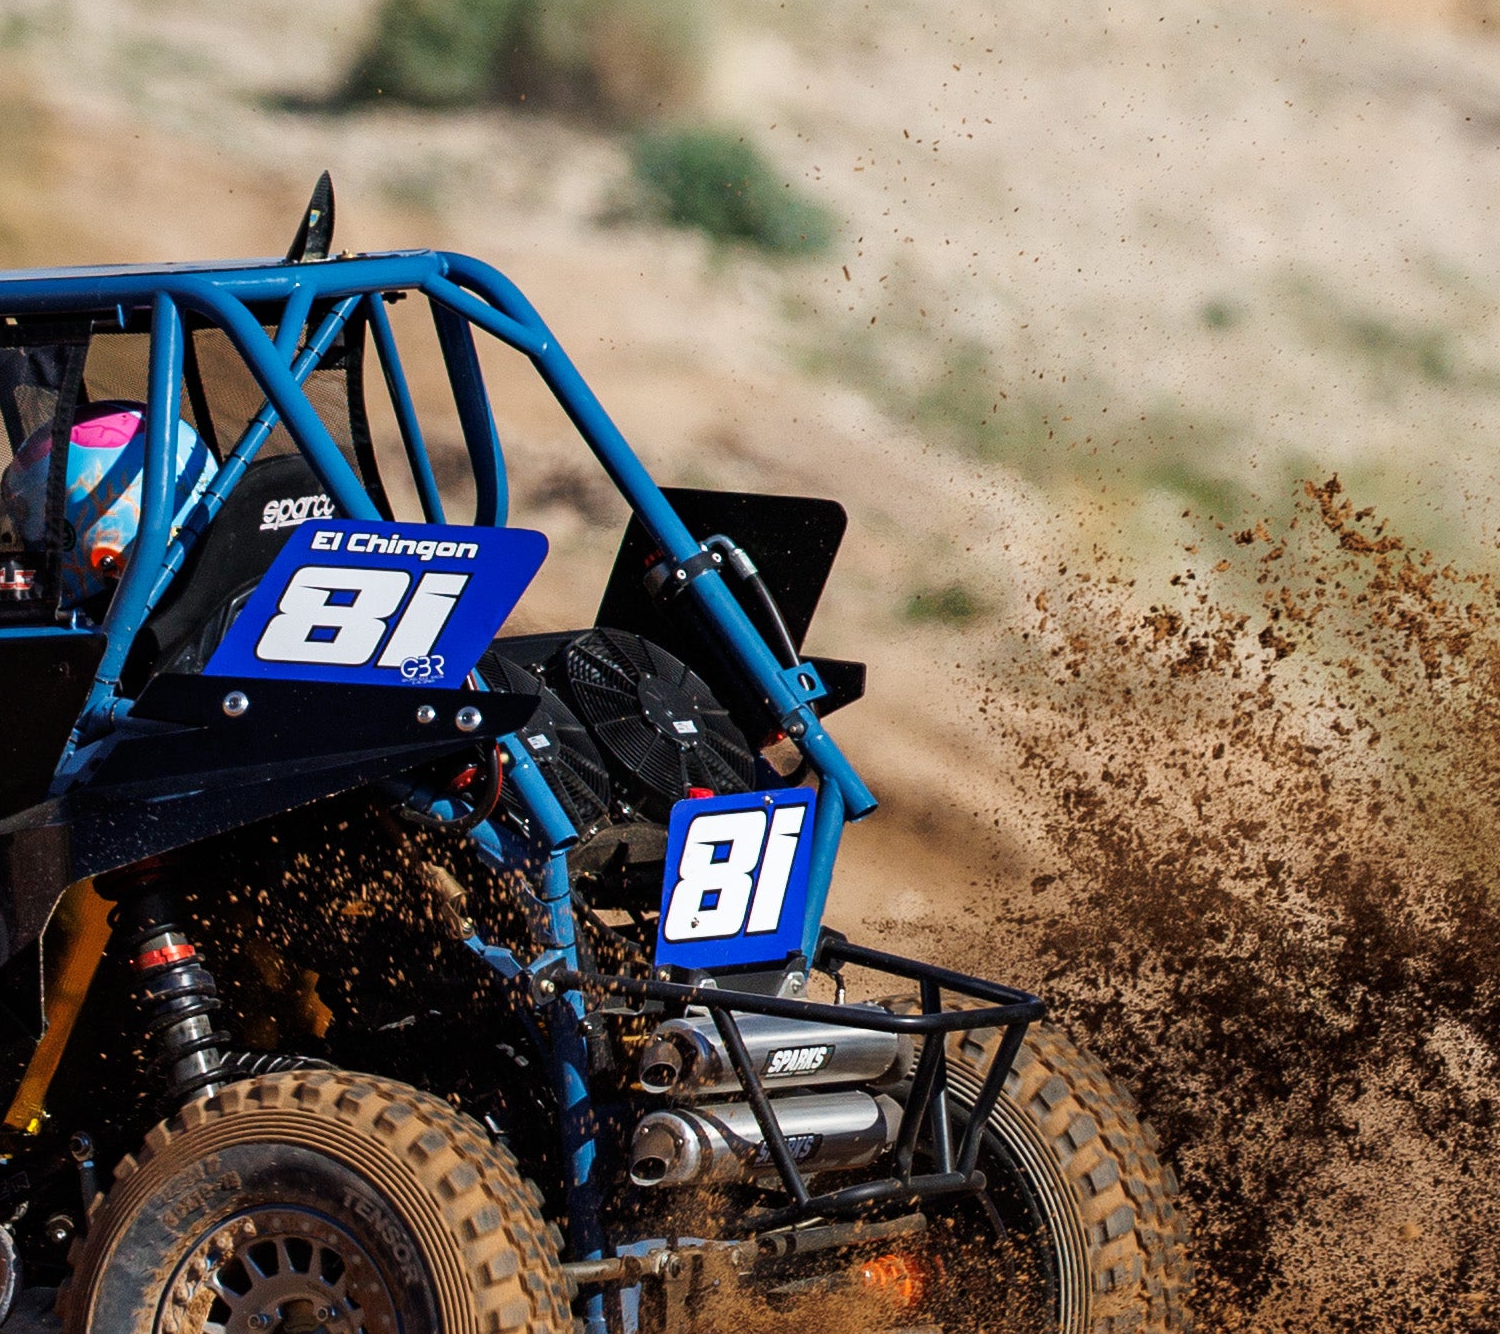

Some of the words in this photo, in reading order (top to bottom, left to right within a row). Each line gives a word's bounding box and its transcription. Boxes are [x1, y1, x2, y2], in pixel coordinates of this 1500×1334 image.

[311, 530, 344, 551] El
[347, 533, 479, 561] Chingon
[255, 565, 472, 668] 81
[400, 655, 445, 678] GBR
[664, 803, 808, 943] 81
[767, 1047, 827, 1073] SPARKS
[342, 1186, 419, 1284] TENSOR
